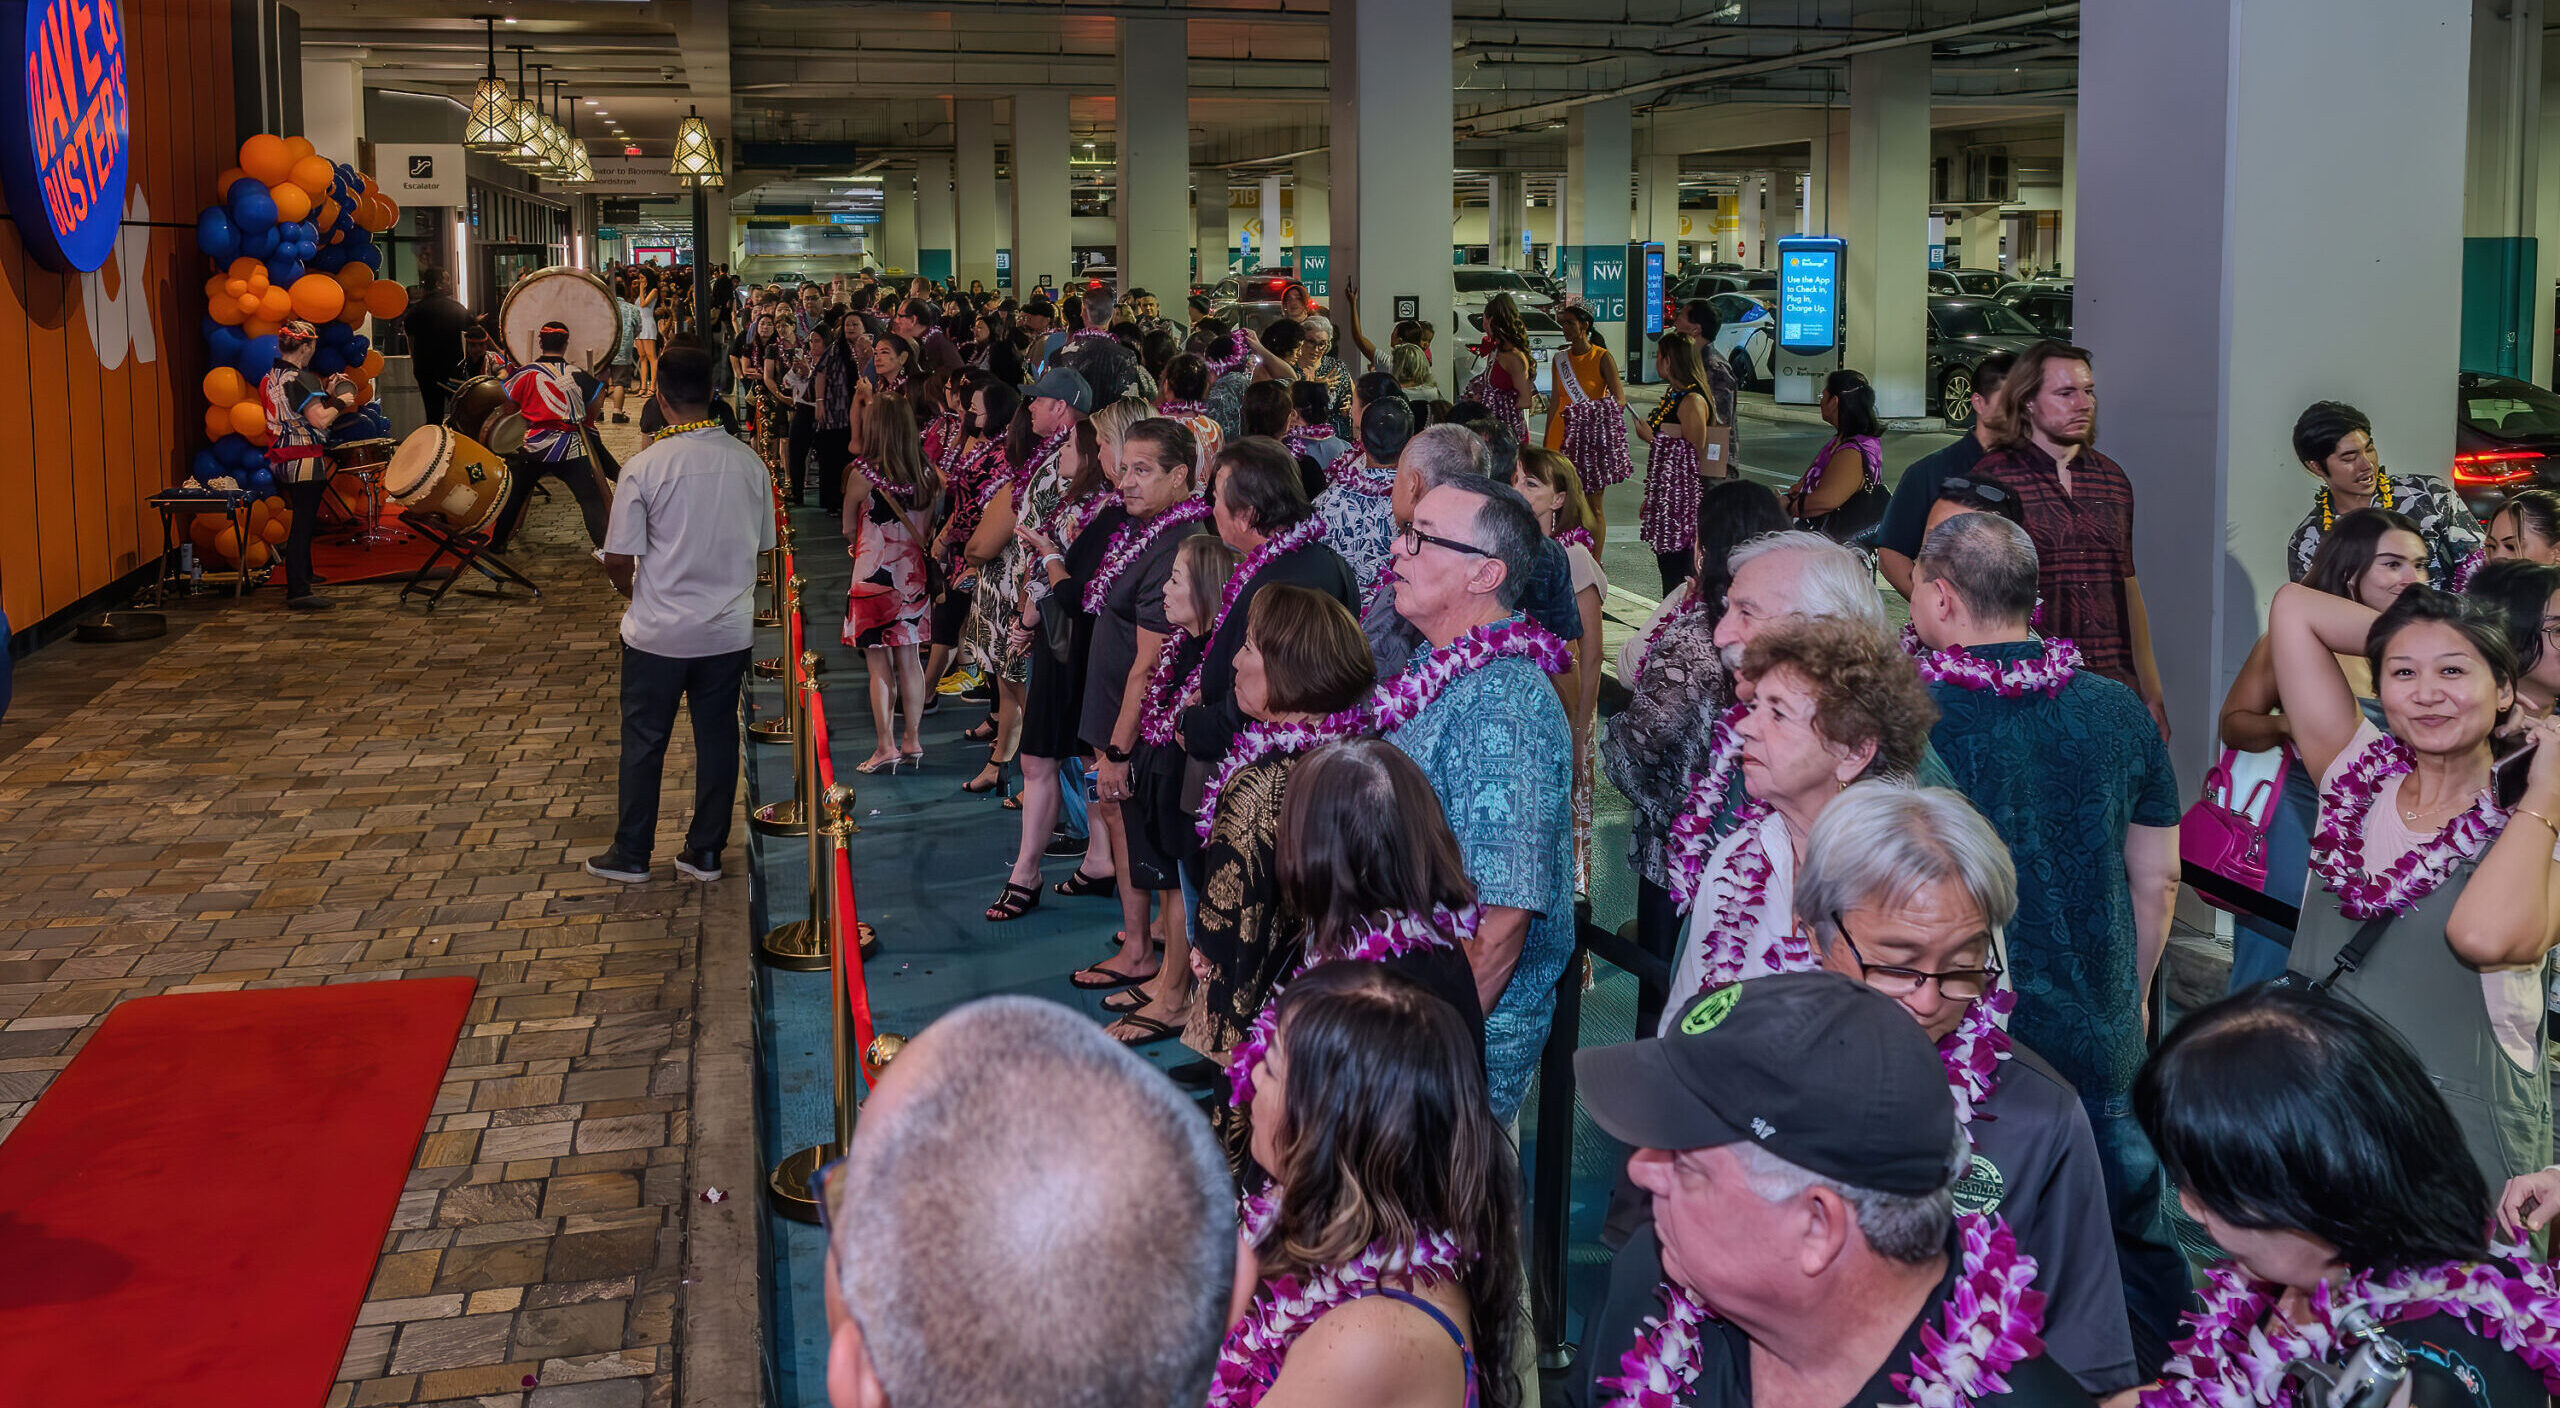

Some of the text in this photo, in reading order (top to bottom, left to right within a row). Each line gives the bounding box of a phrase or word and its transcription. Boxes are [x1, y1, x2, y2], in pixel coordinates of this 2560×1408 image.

[29, 0, 119, 171] DAVE &
[44, 51, 127, 236] BUSTER'S
[403, 182, 440, 190] Escalator
[1305, 258, 1326, 270] NW
[1593, 264, 1623, 281] NW
[1787, 275, 1831, 285] Use the App
[1319, 284, 1327, 294] B
[1795, 285, 1817, 293] Check
[1786, 294, 1802, 304] Plug
[1613, 303, 1625, 318] C
[1786, 304, 1813, 314] Charge
